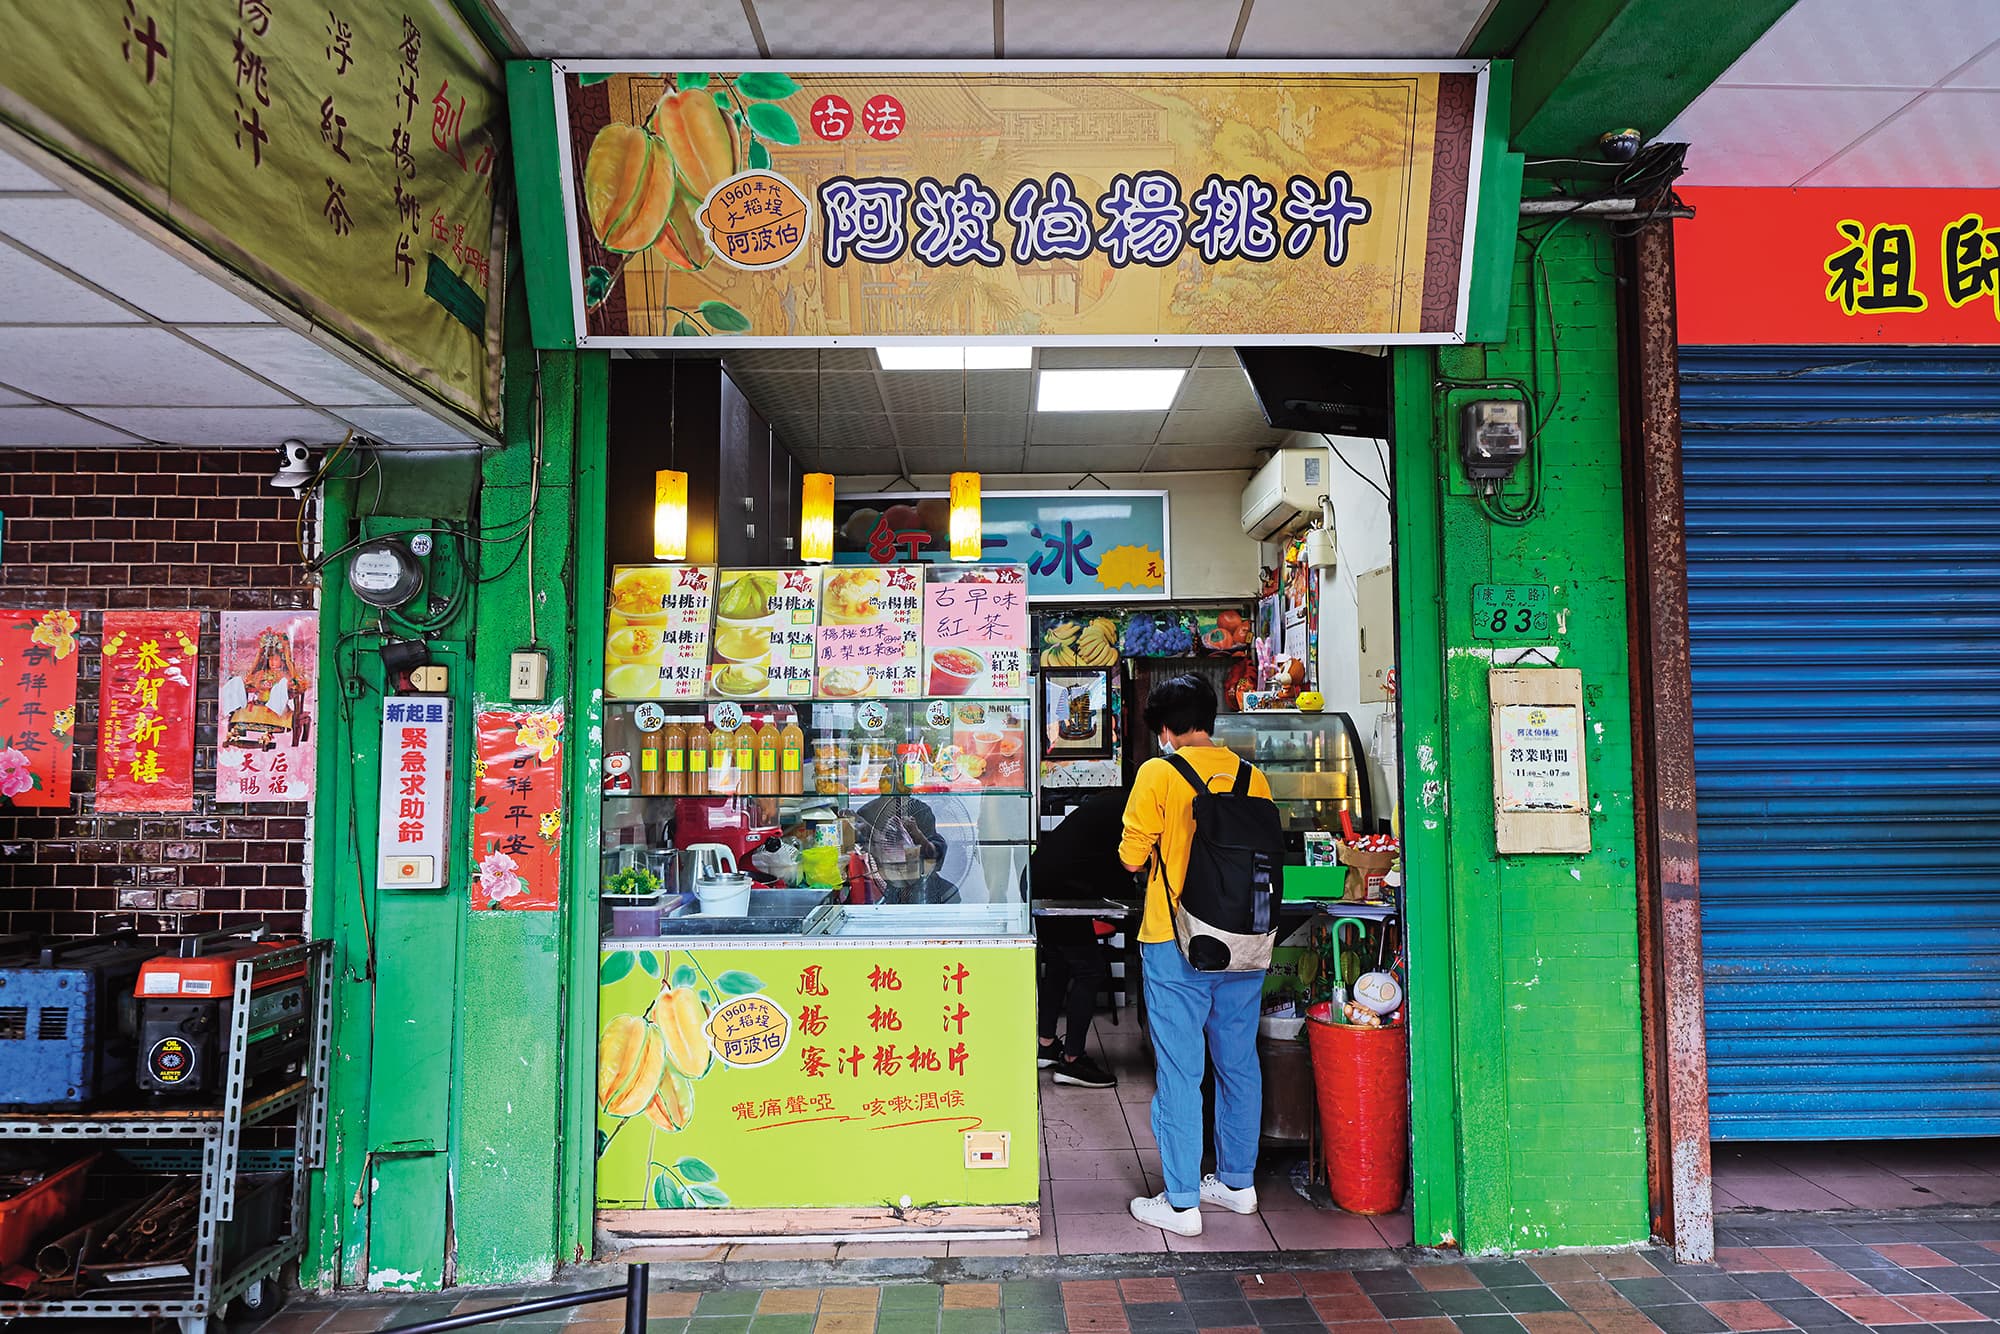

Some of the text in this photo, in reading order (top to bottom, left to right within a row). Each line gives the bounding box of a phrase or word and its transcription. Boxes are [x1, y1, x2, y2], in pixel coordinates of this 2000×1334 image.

[814, 99, 901, 137] 古法
[719, 181, 783, 209] 1960年代
[727, 198, 784, 229] 大稻埕
[819, 172, 1369, 265] 阿波伯楊桃汁
[726, 223, 799, 257] 阿波伯
[1146, 561, 1162, 579] 元
[661, 594, 710, 608] 楊桃汁
[768, 595, 815, 610] 楊桃冰
[935, 586, 1020, 615] 古早味
[662, 630, 706, 644] 鳳桃汁
[770, 631, 813, 645] 鳳梨冰
[937, 614, 1009, 640] 紅茶
[821, 643, 884, 661] 鳳梨紅茶
[659, 666, 703, 680] 鳳梨汁
[767, 666, 812, 679] 鳳桃冰
[992, 659, 1020, 672] 紅茶
[16, 645, 52, 752] 吉祥平安
[127, 639, 169, 783] 恭賀新禧
[386, 703, 444, 723] 新起里
[1509, 748, 1569, 763] 營業時間
[398, 727, 428, 843] 緊急求助鈴
[796, 962, 971, 997] 鳳桃汁
[721, 1002, 769, 1022] 1960年代
[798, 1003, 971, 1036] 楊桃汁
[726, 1014, 770, 1037] 大稻埕
[724, 1032, 780, 1058] 阿波伯
[799, 1041, 968, 1077] 蜜汁楊桃片
[731, 1089, 966, 1120] 嚨痛聲啞 咳嗽潤喉
